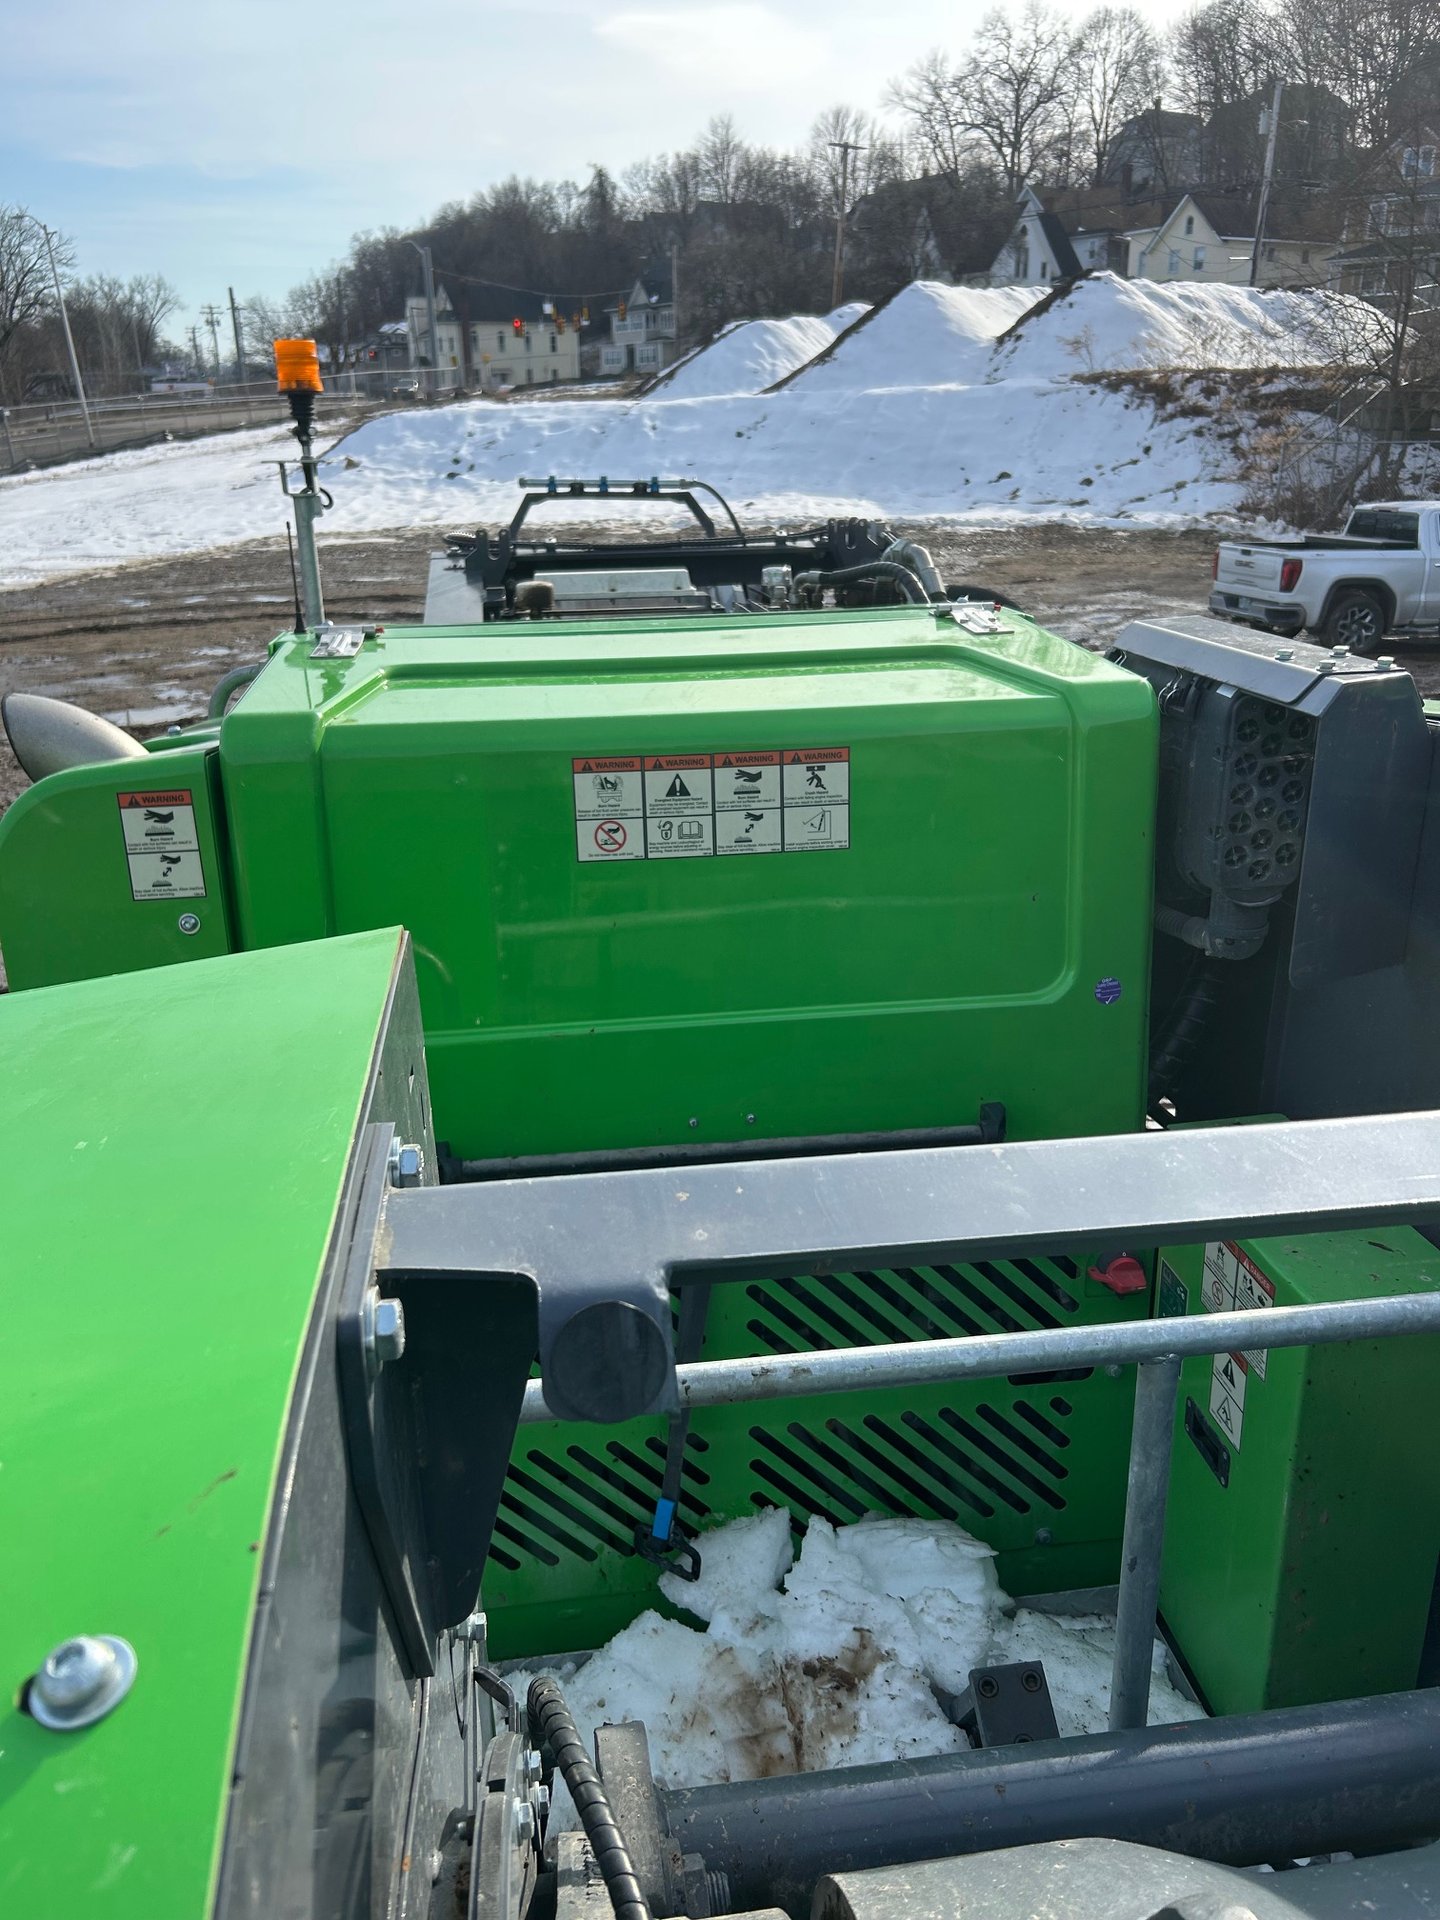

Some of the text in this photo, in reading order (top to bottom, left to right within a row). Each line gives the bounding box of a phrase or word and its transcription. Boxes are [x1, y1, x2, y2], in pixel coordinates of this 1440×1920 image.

[734, 755, 774, 763] WARNING
[804, 751, 843, 760] WARNING
[594, 760, 635, 769] WARNING
[665, 758, 705, 767] WARNING
[141, 794, 185, 804] WARNING
